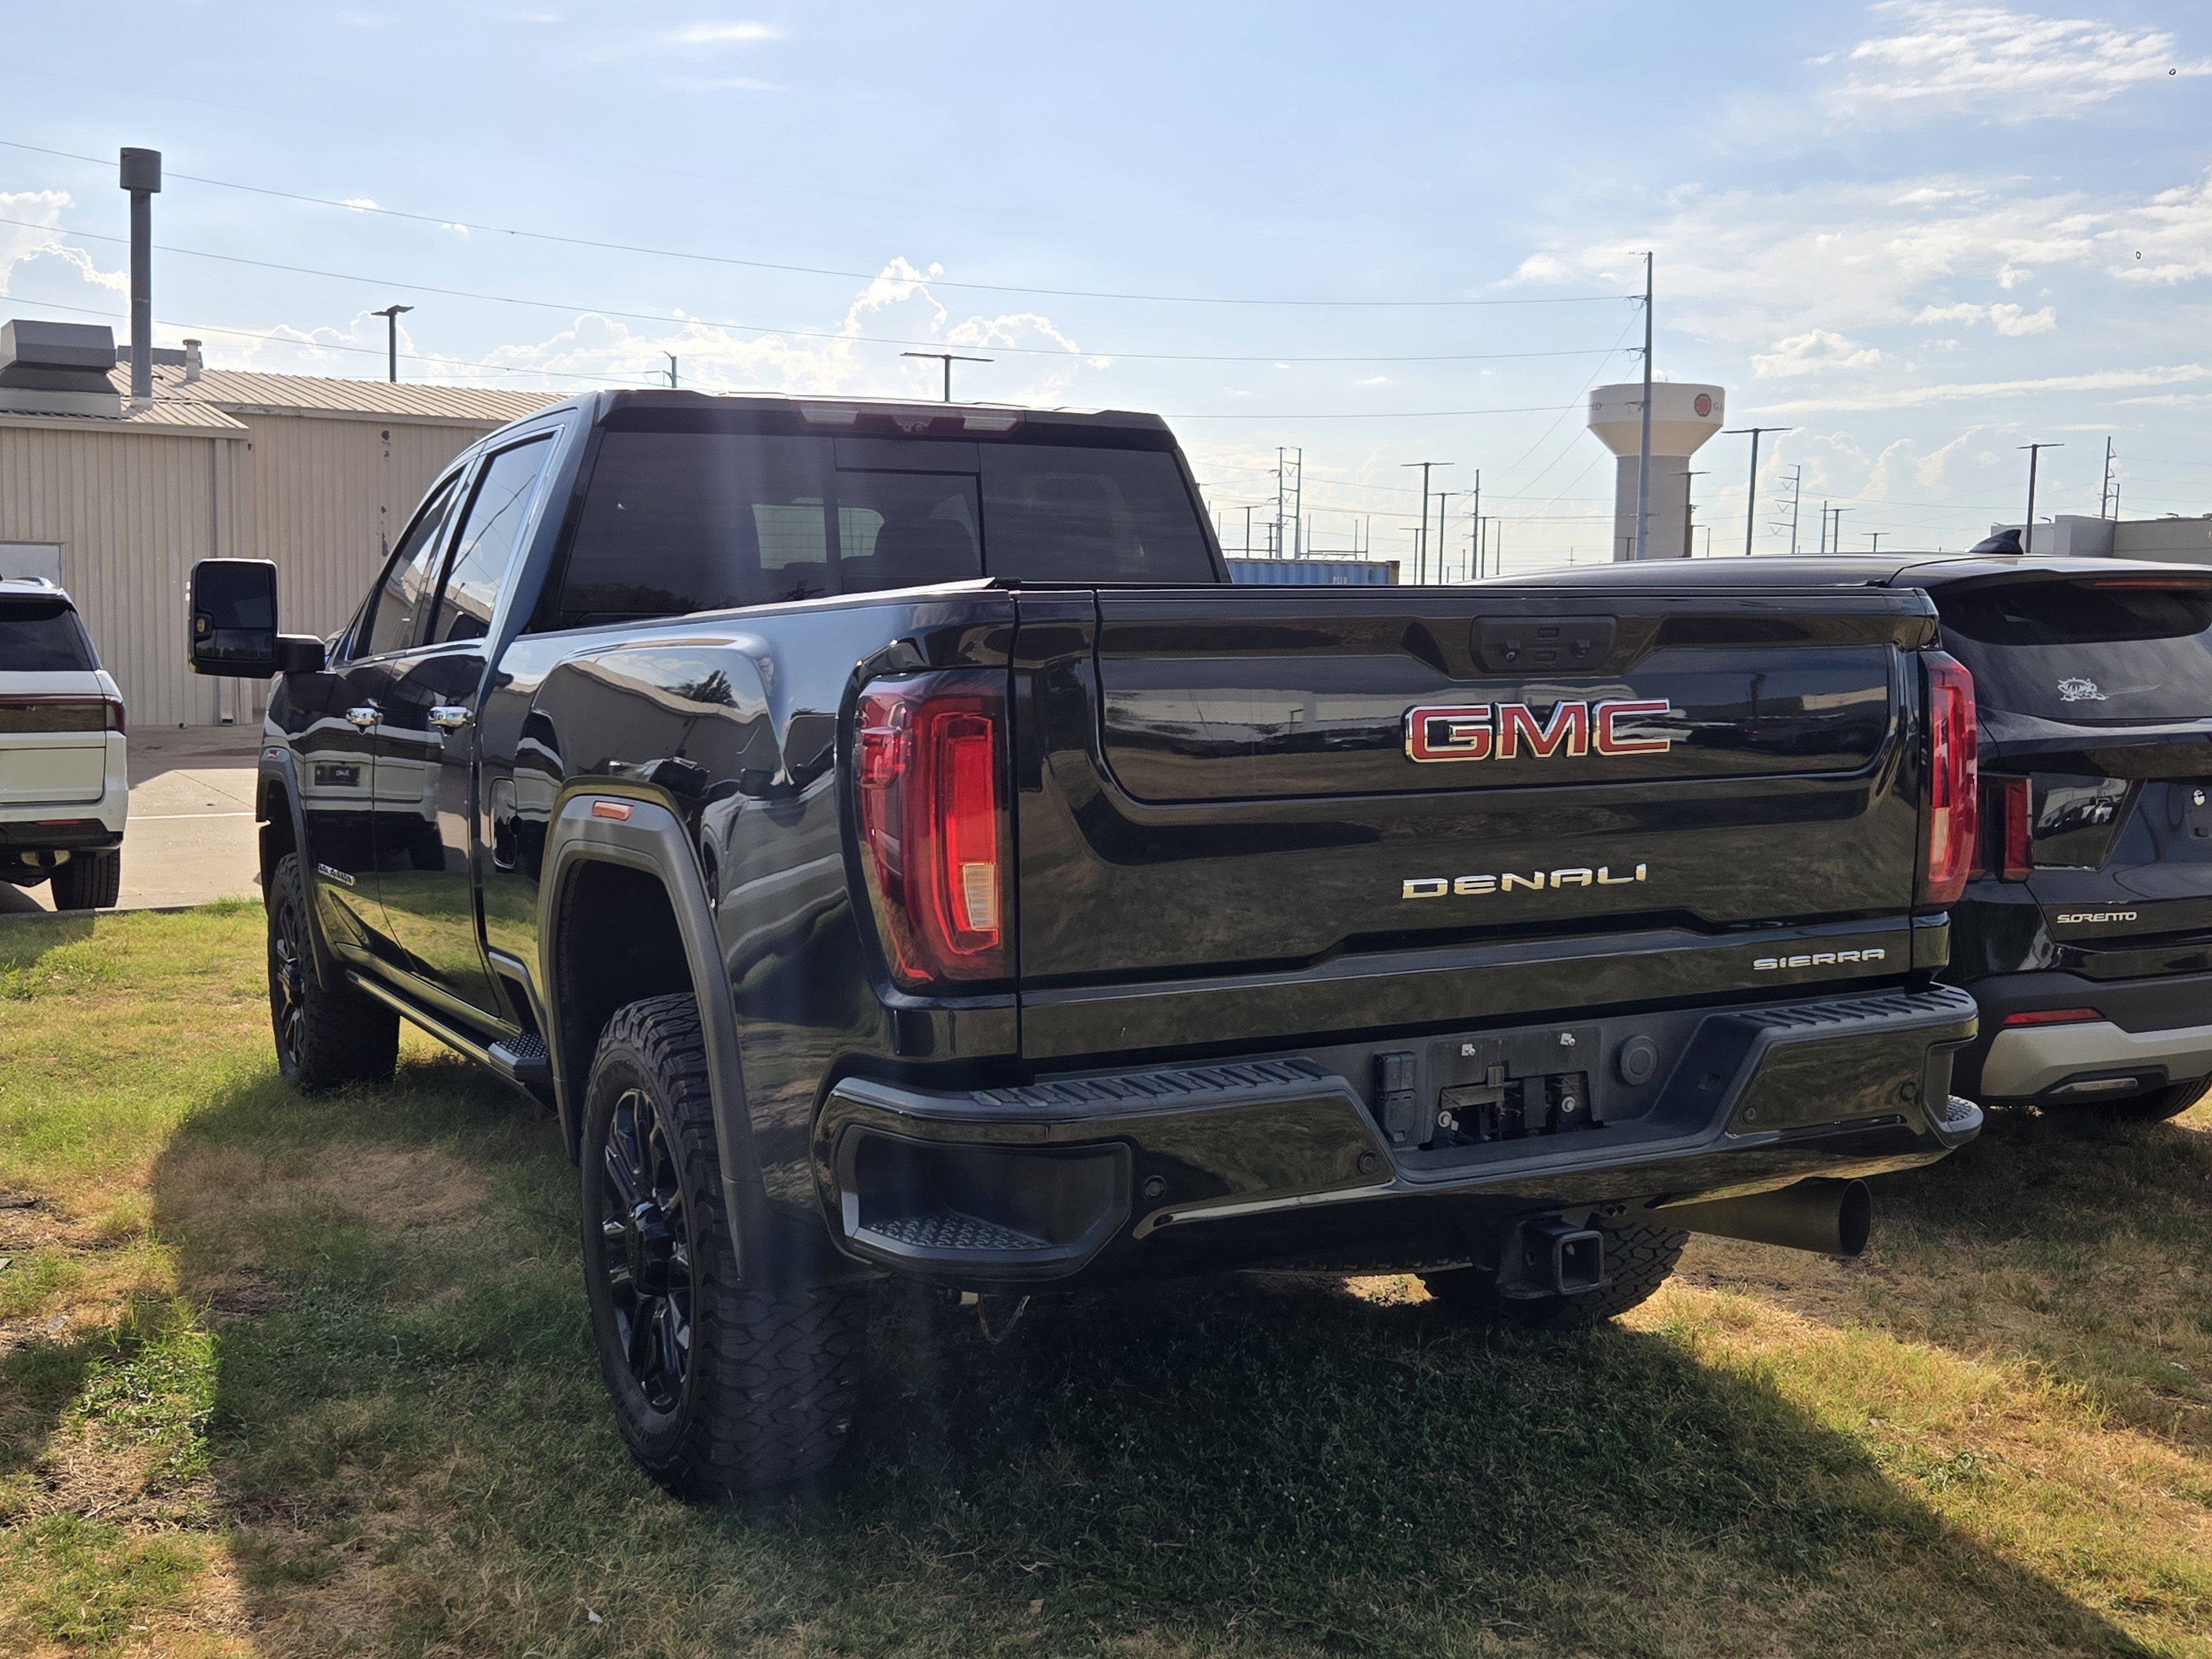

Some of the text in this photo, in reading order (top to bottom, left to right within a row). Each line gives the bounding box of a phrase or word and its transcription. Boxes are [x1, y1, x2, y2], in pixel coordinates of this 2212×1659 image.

[1405, 698, 1670, 763] GMC
[1402, 863, 1646, 899] DENALI
[2057, 912, 2137, 924] SORENTO
[1754, 948, 1885, 970] SIERRA
